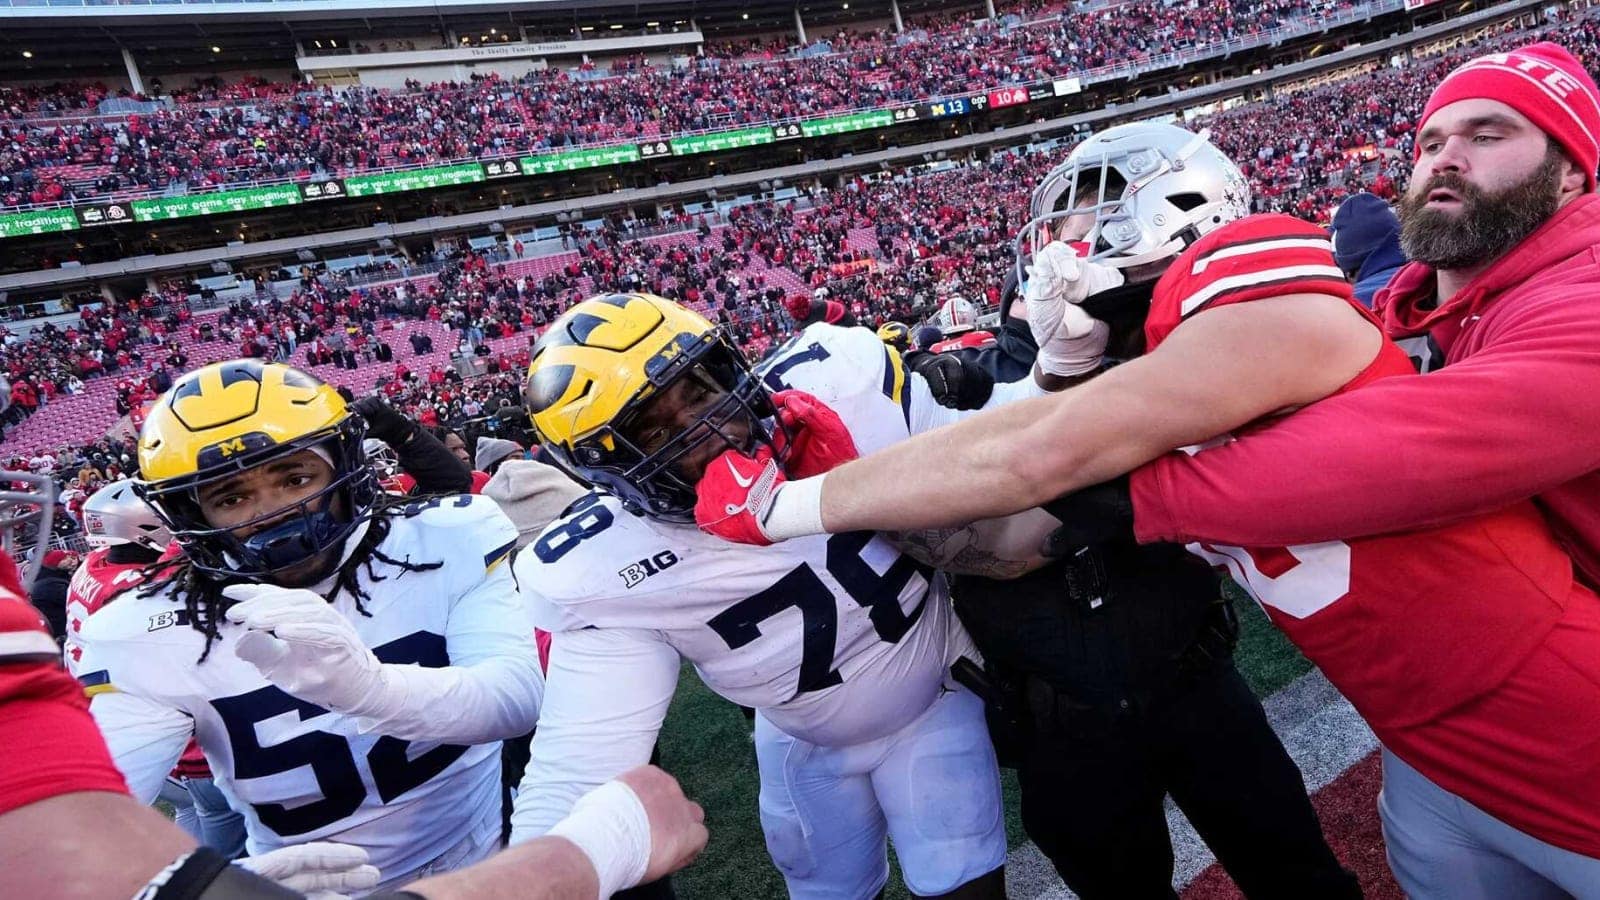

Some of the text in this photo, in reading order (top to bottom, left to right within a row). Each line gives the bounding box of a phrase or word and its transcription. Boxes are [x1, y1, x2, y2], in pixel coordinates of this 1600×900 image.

[971, 95, 987, 104] 0:00
[996, 93, 1012, 105] 10
[949, 101, 963, 113] 13
[442, 169, 482, 180] traditions
[135, 204, 161, 214] feed
[164, 203, 188, 213] your
[192, 198, 223, 210] game
[226, 195, 247, 205] day
[250, 190, 298, 201] traditions
[15, 216, 74, 228] traditions
[660, 341, 682, 361] M
[217, 438, 246, 457] M
[618, 550, 678, 589] BIG
[706, 529, 935, 693] 78
